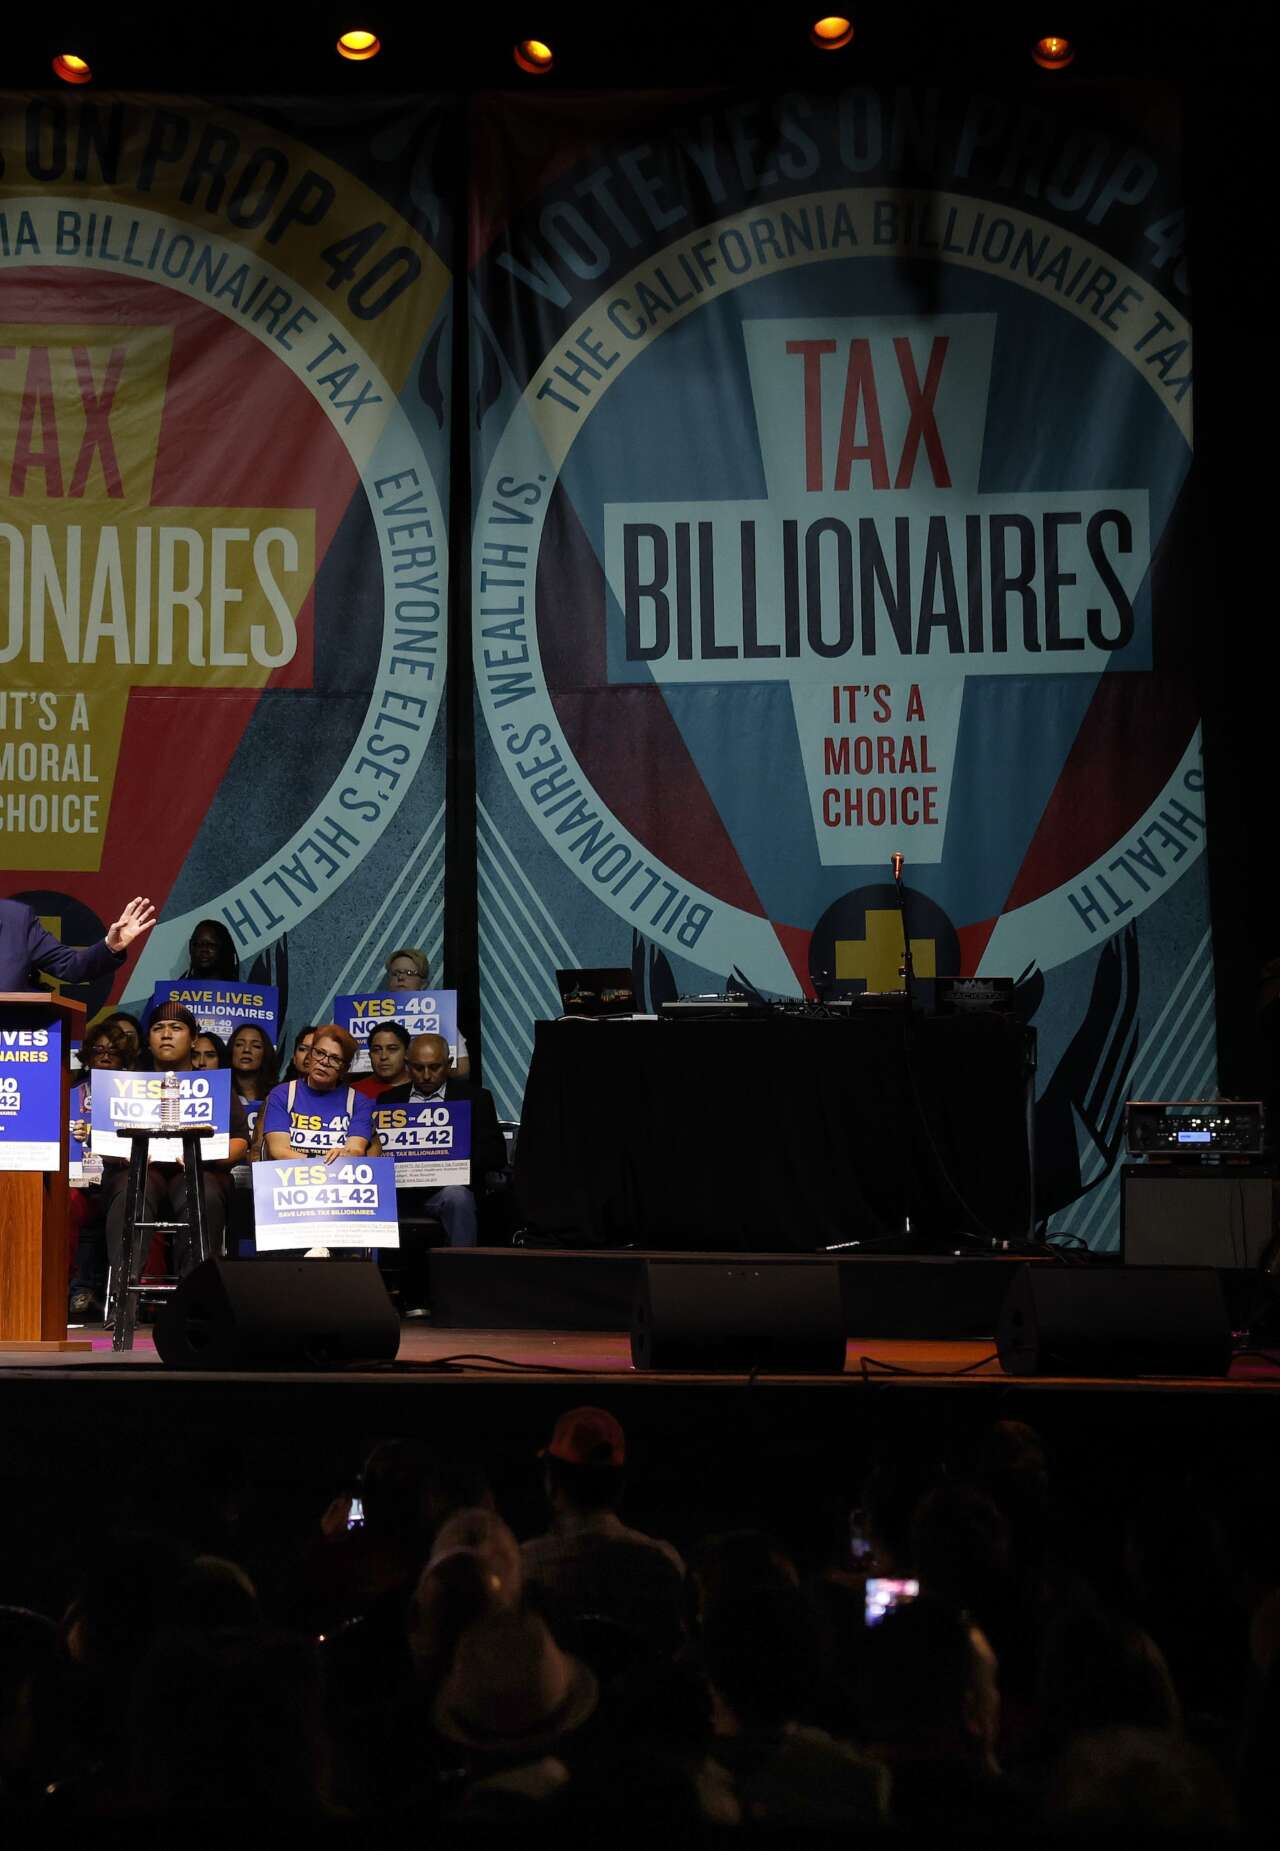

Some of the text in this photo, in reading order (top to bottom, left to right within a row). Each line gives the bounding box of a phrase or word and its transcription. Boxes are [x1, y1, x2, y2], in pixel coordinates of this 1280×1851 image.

[27, 95, 119, 184] ON
[137, 102, 334, 248] PROP
[321, 220, 423, 322] 40
[494, 139, 687, 310] VOTE
[684, 94, 822, 204] YES
[840, 86, 944, 172] ON
[953, 92, 1163, 228] PROP
[57, 211, 319, 346] BILLIONAIRE
[307, 333, 383, 425] TAX
[536, 332, 620, 415] THE
[607, 200, 858, 341] CALIFORNIA
[874, 202, 1144, 332] BILLIONAIRE
[785, 336, 952, 491] TAX
[496, 472, 548, 526] VS.
[622, 509, 1134, 660] BILLIONAIRES
[480, 544, 537, 709] WEALTH
[0, 692, 88, 731] IT'S A
[221, 467, 440, 947] EVERYONE ELSE'S HEALTH
[832, 683, 924, 724] IT'S A
[823, 736, 936, 776] MORAL
[822, 786, 939, 828] CHOICE
[1067, 798, 1207, 933] HEALTH
[170, 990, 264, 1006] SAVE LIVES
[187, 1005, 274, 1020] BILLIONAIRES
[353, 997, 436, 1017] YES-40
[275, 1164, 373, 1187] YES-40
[278, 1190, 308, 1206] NO
